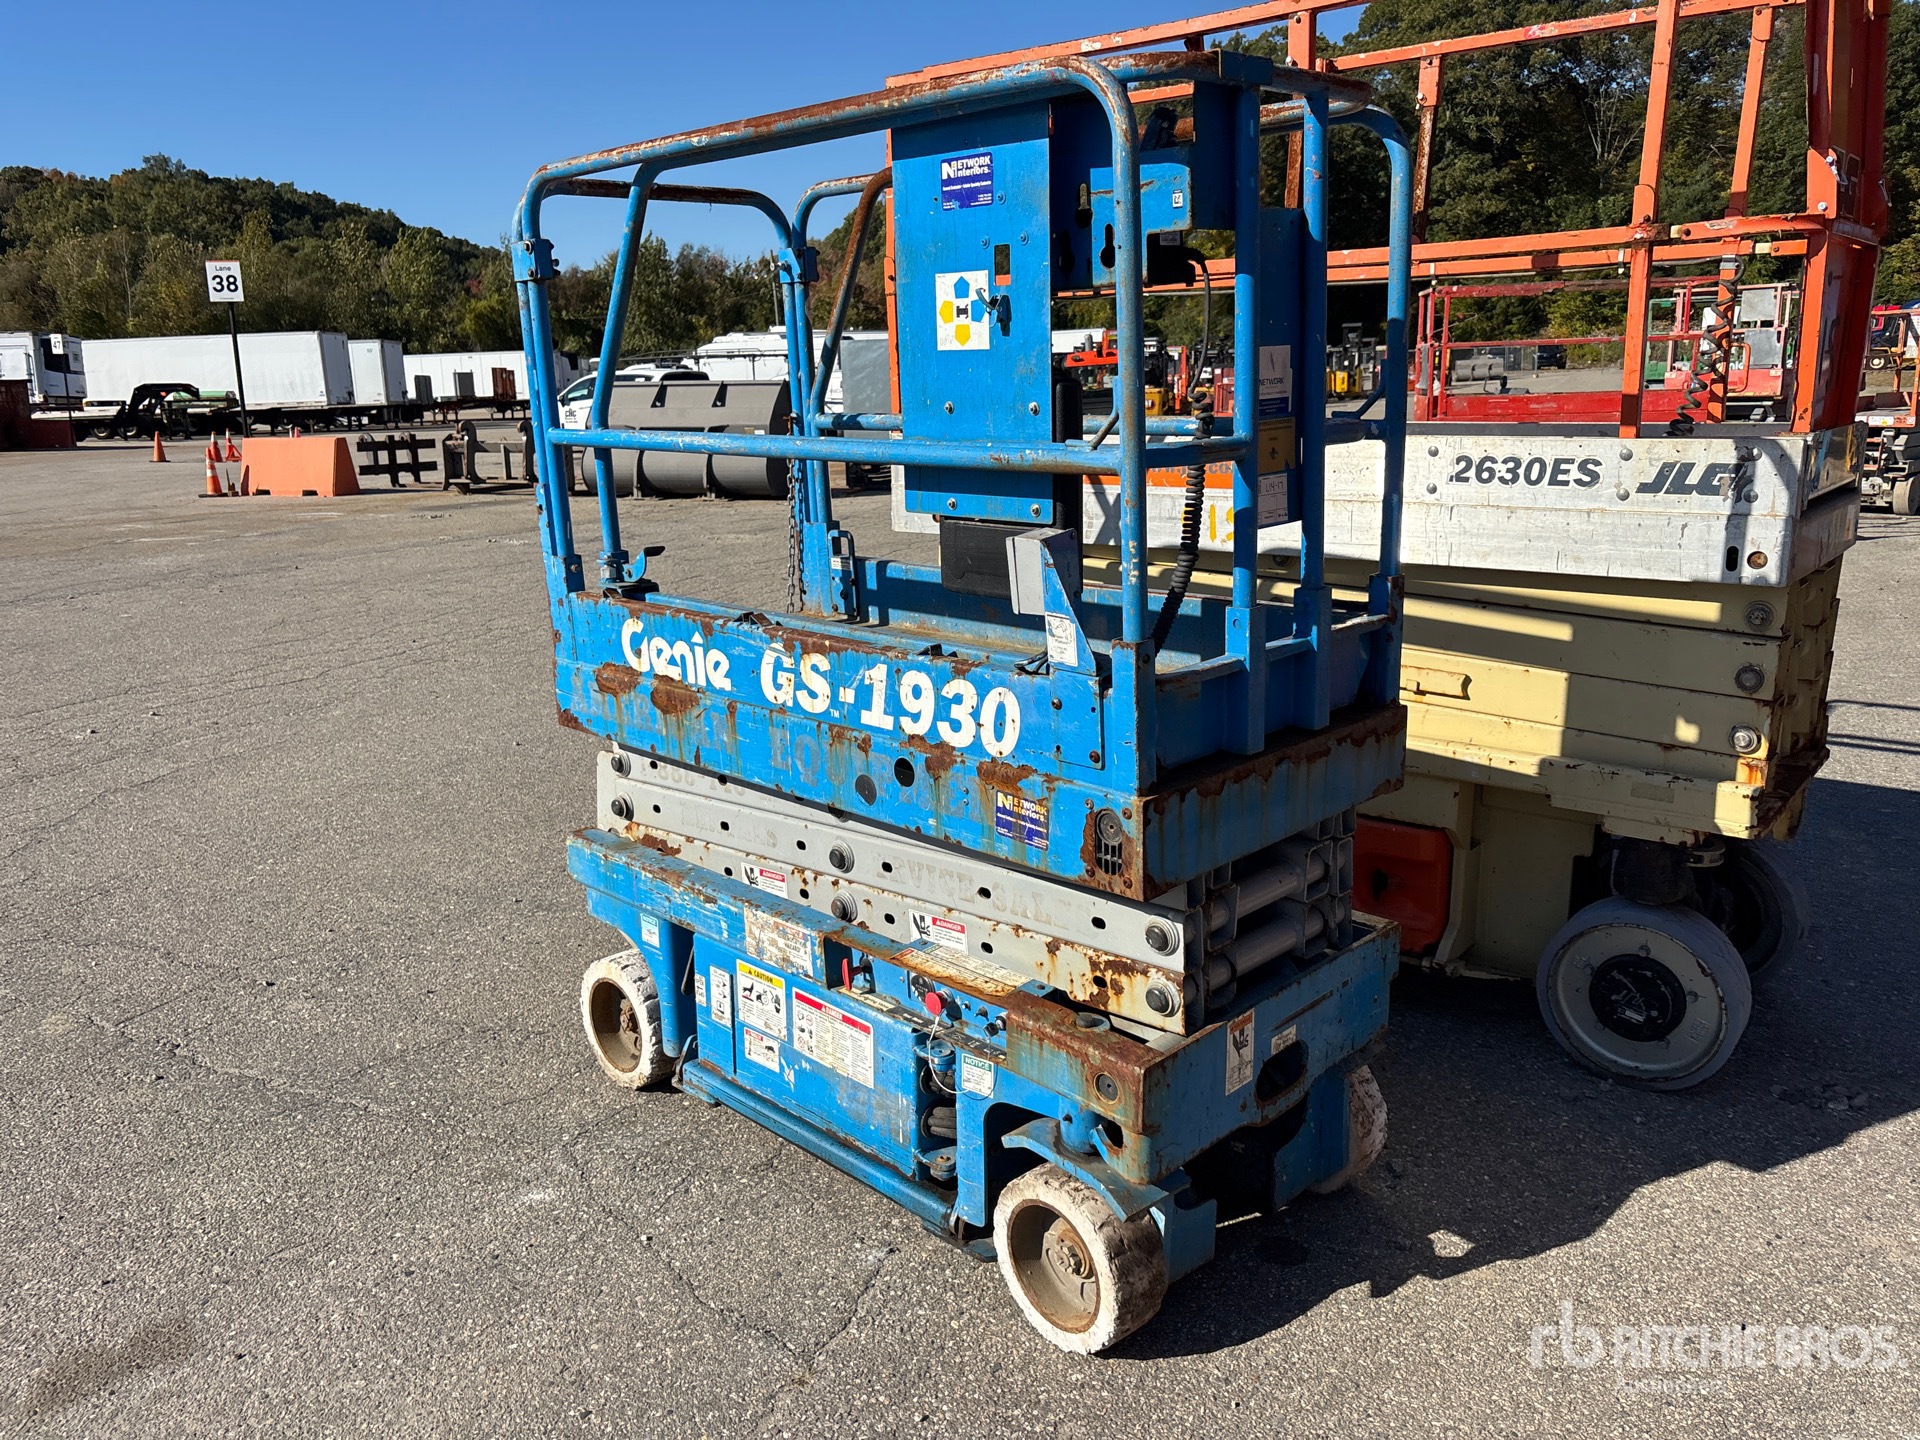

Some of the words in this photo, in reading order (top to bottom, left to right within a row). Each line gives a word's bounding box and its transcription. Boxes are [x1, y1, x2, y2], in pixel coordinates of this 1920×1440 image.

[211, 274, 239, 293] 38
[53, 340, 61, 350] 47
[1451, 455, 1604, 488] 2630ES
[1635, 461, 1744, 497] JLG
[621, 617, 732, 691] Genie
[940, 920, 962, 932] DANGER
[753, 969, 774, 984] CAUTION
[825, 1005, 841, 1020] DANGER
[965, 1056, 990, 1071] NOTICE
